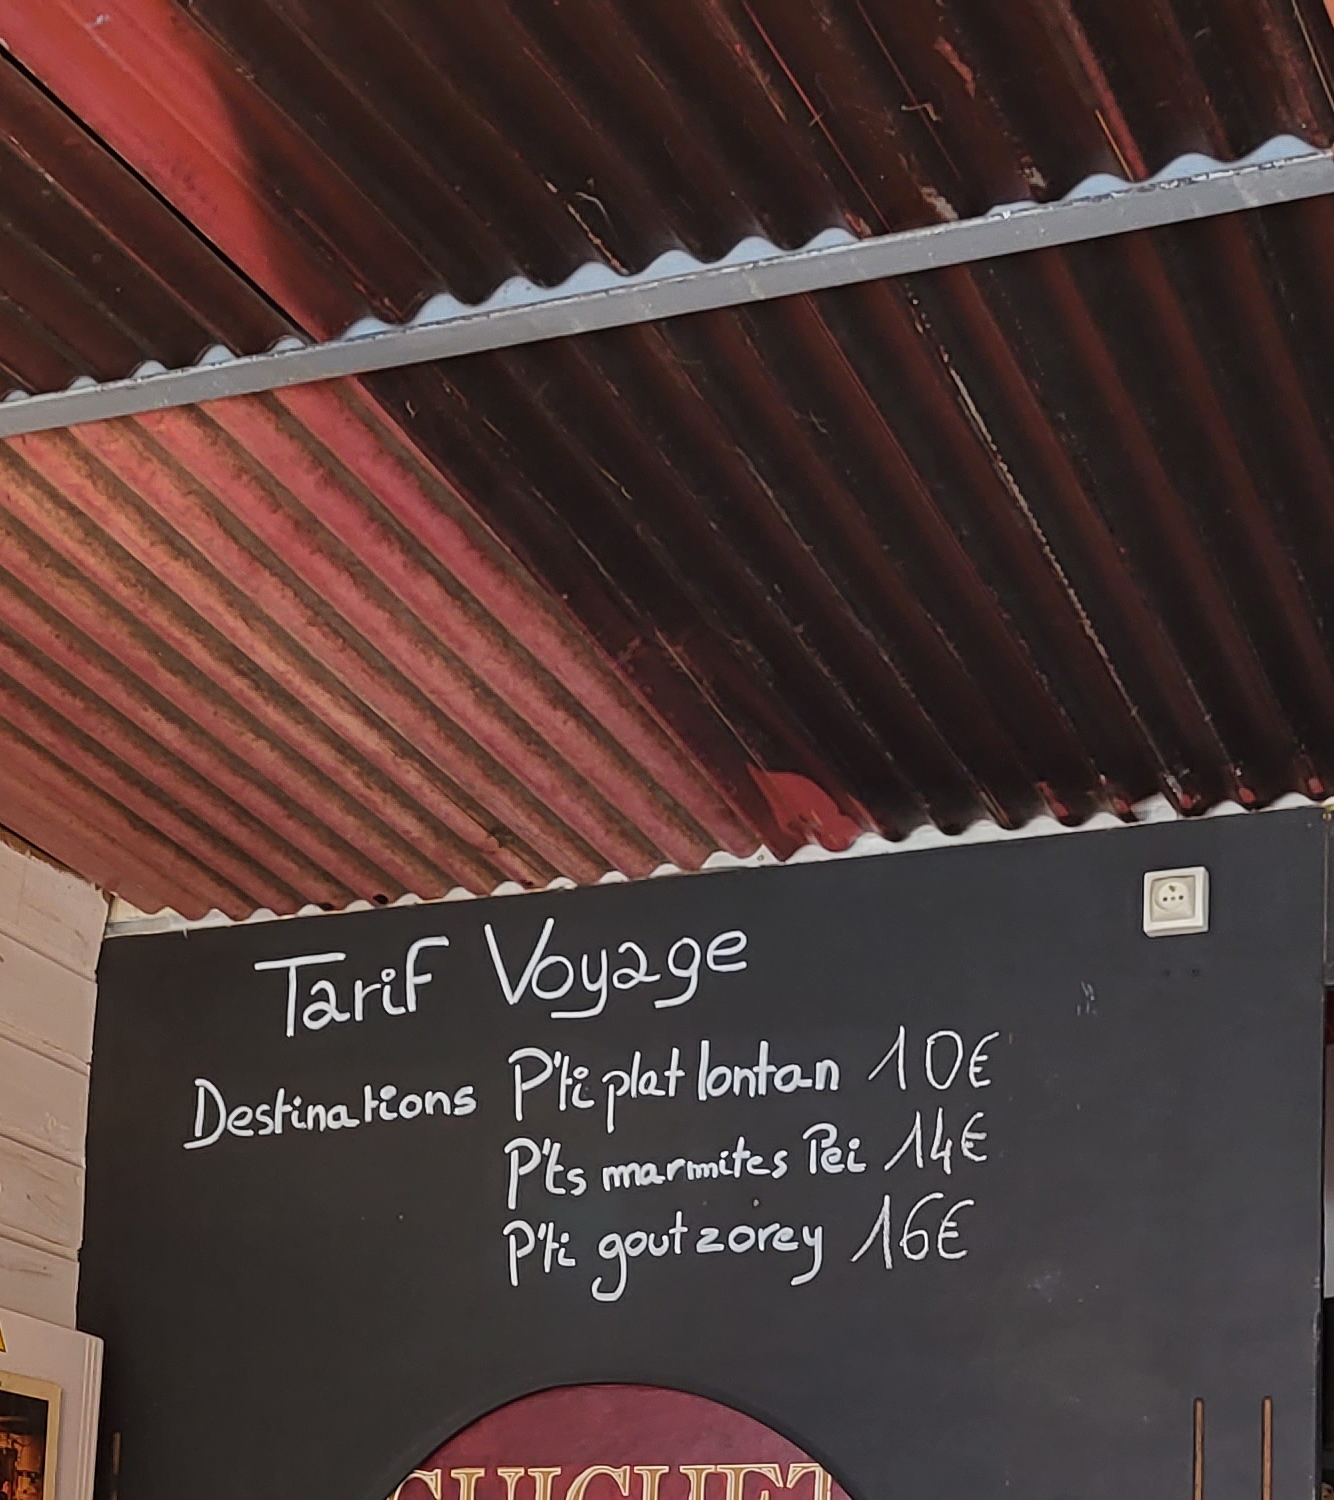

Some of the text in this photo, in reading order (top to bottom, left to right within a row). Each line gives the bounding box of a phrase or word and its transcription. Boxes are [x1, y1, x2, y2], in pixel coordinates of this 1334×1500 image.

[483, 917, 749, 1019] Voyage
[183, 1078, 478, 1150] Destinations
[602, 1046, 685, 1133] plat
[697, 1040, 840, 1101] lontan
[867, 1025, 1001, 1091] 10€
[602, 1136, 788, 1190] marmites
[883, 1107, 989, 1174] 14€
[850, 1192, 975, 1270] 16€
